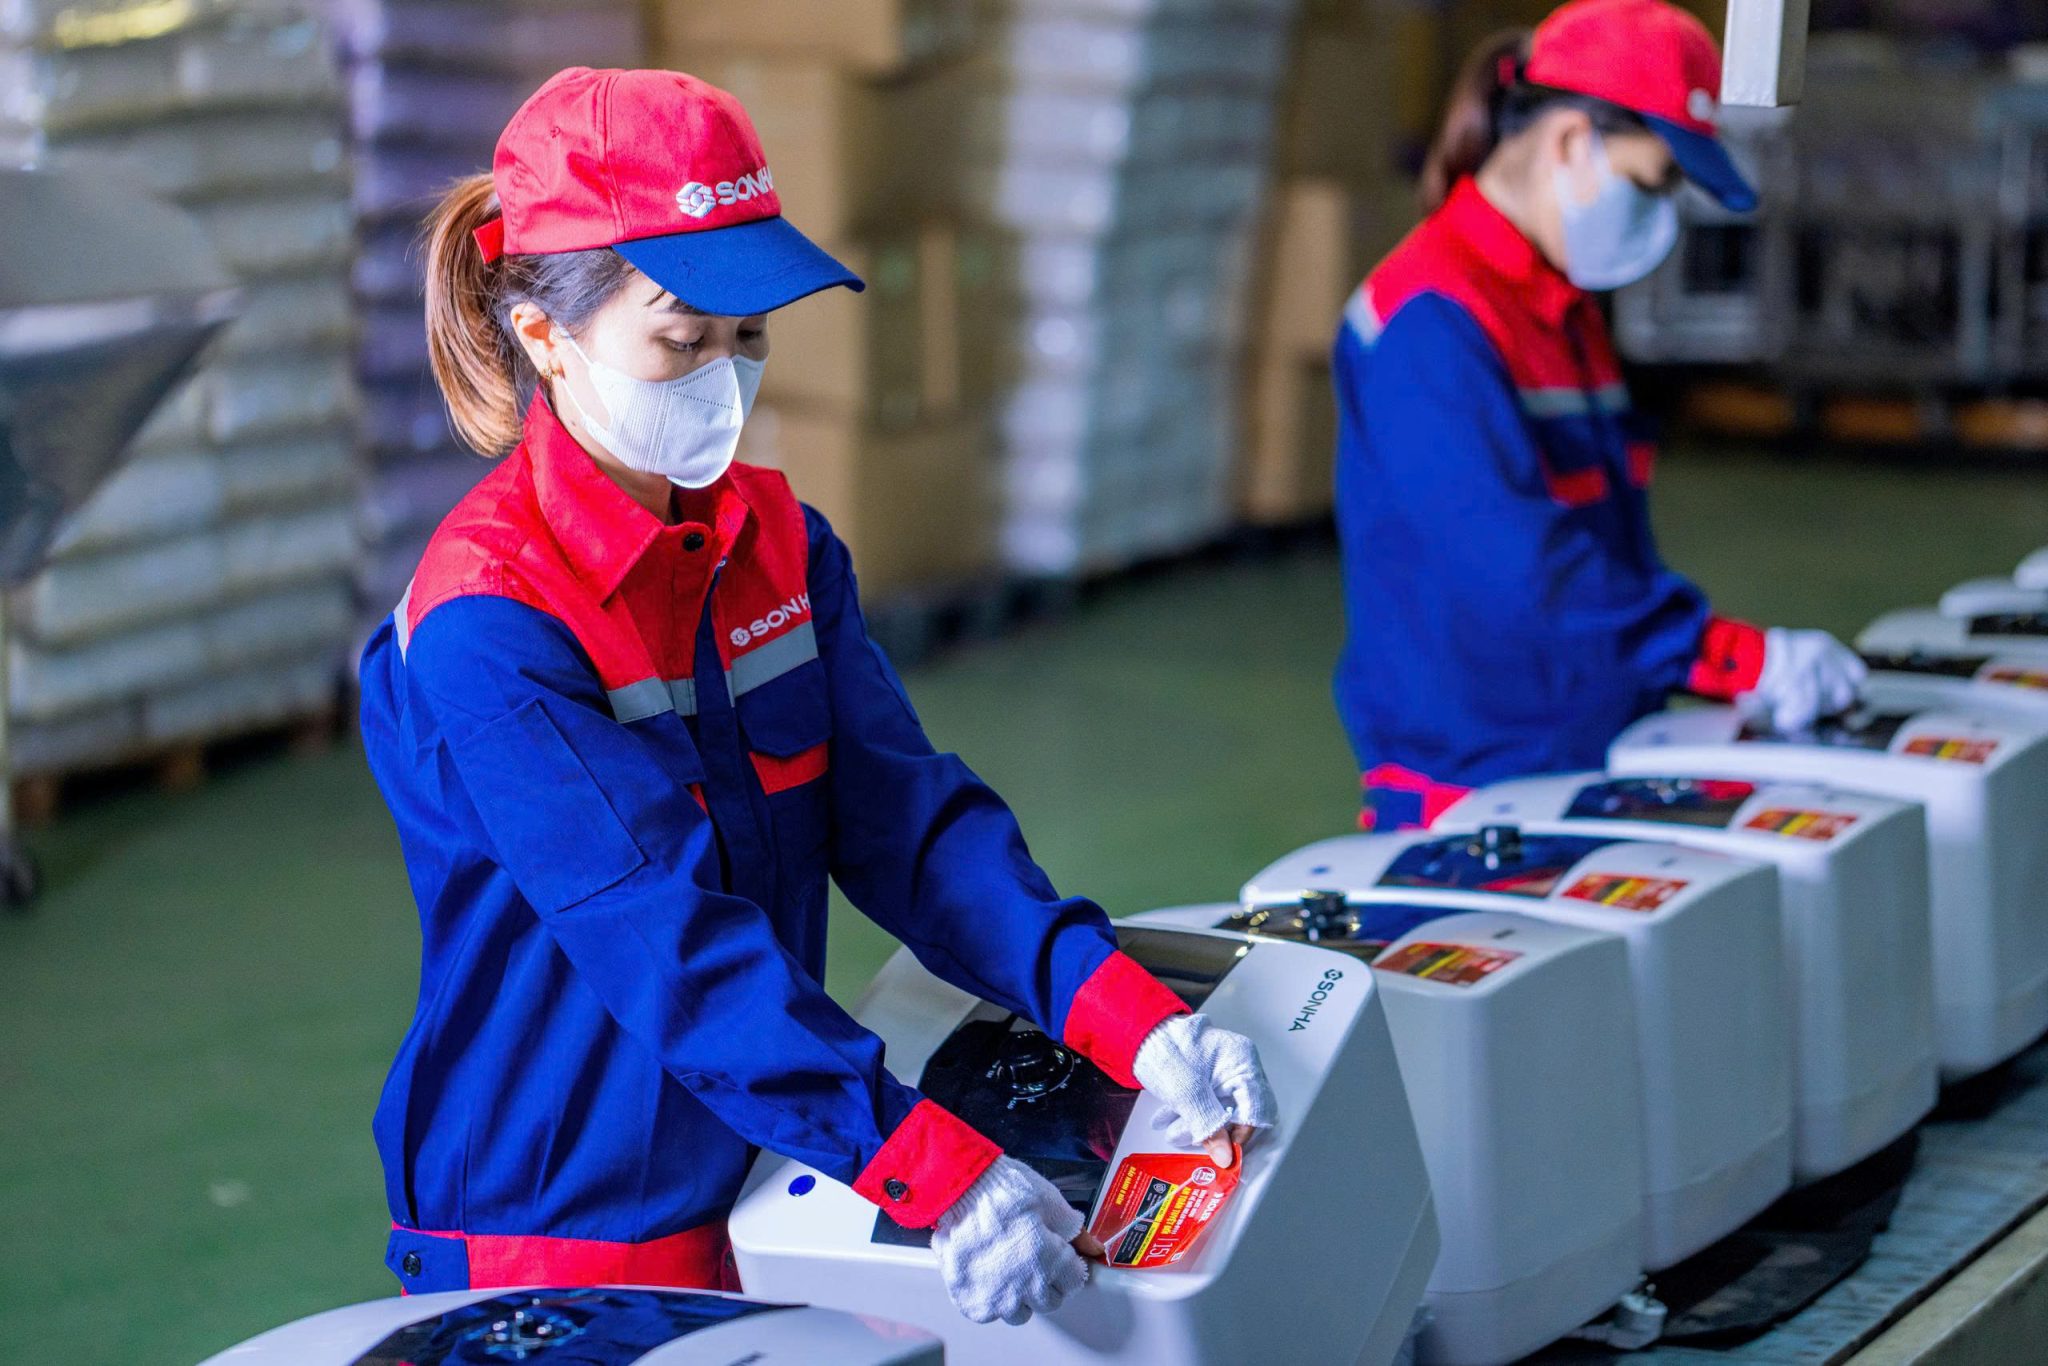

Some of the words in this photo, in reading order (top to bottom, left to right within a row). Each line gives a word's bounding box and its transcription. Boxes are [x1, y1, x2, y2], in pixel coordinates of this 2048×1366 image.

[715, 165, 774, 205] SONH
[749, 591, 811, 637] SONH
[1288, 980, 1335, 1031] SONHA
[1145, 1242, 1173, 1262] 15L
